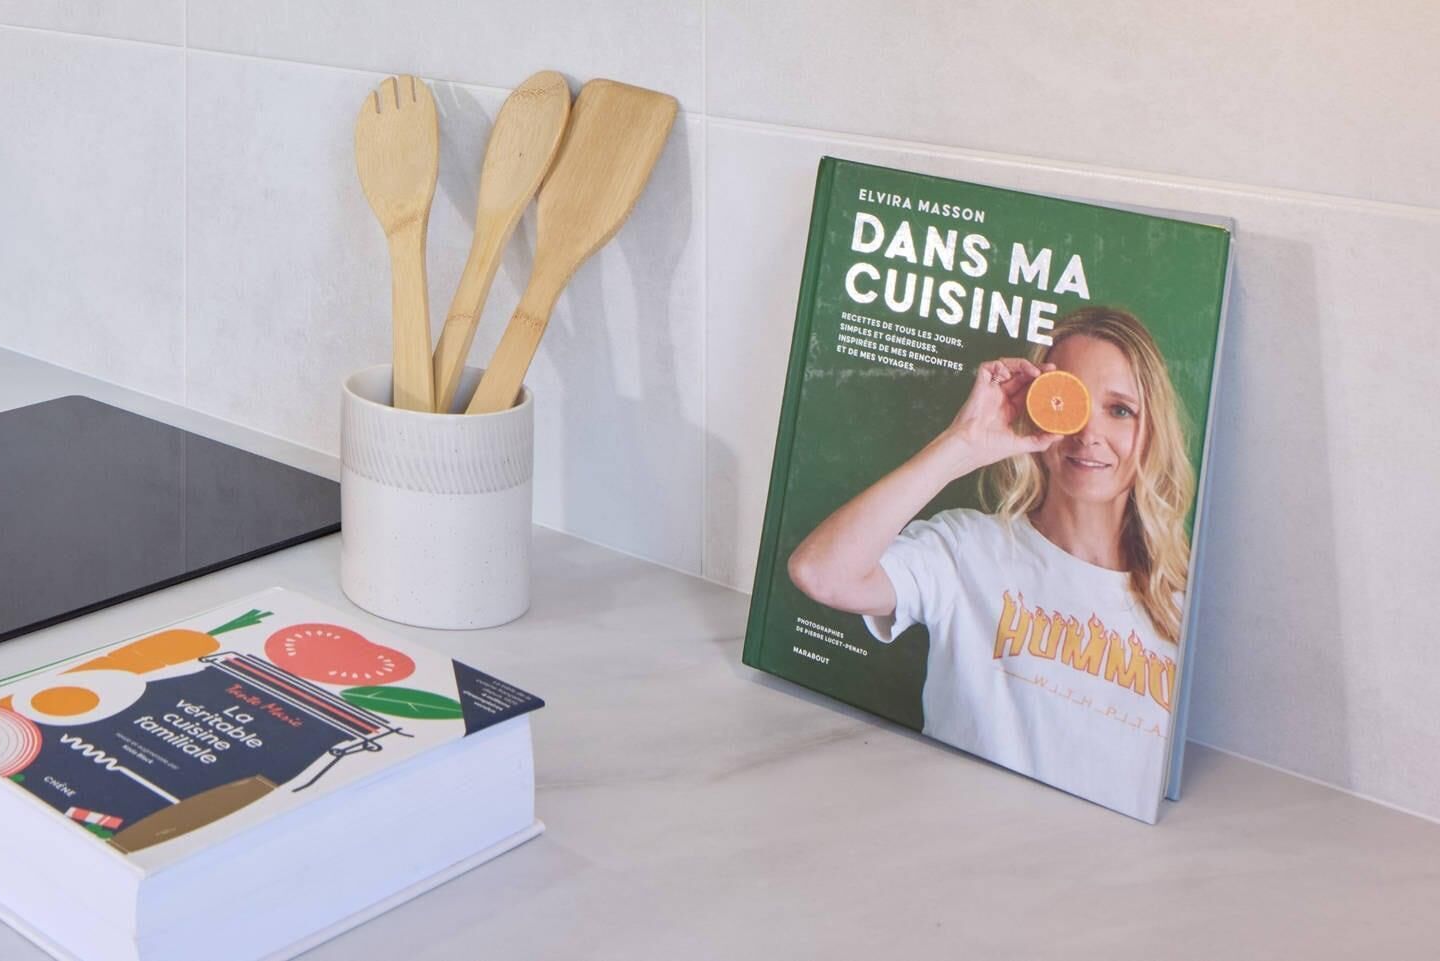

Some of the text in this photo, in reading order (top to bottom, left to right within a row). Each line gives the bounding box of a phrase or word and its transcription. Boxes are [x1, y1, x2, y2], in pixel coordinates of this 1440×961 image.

[858, 188, 985, 223] ELVIRA MASSON
[851, 211, 1090, 300] DANS MA
[844, 262, 1058, 346] CUISINE
[839, 322, 872, 337] SIMPLES
[873, 331, 885, 340] ET
[841, 311, 881, 328] RECETTES
[882, 321, 893, 330] DE
[895, 324, 916, 336] TOUS
[917, 329, 932, 340] LES
[836, 345, 847, 354] ET
[848, 348, 859, 357] DE
[860, 351, 877, 361] MES
[878, 343, 890, 353] DE
[890, 346, 907, 357] MES
[908, 351, 964, 371] RENCONTRES
[795, 625, 804, 633] DE
[797, 617, 845, 639] PHOTOGRAPHIES
[792, 646, 830, 665] MARABOUT
[176, 699, 263, 748] véritable
[222, 705, 254, 724] La
[133, 715, 217, 764] familiale
[163, 713, 230, 751] cuisine
